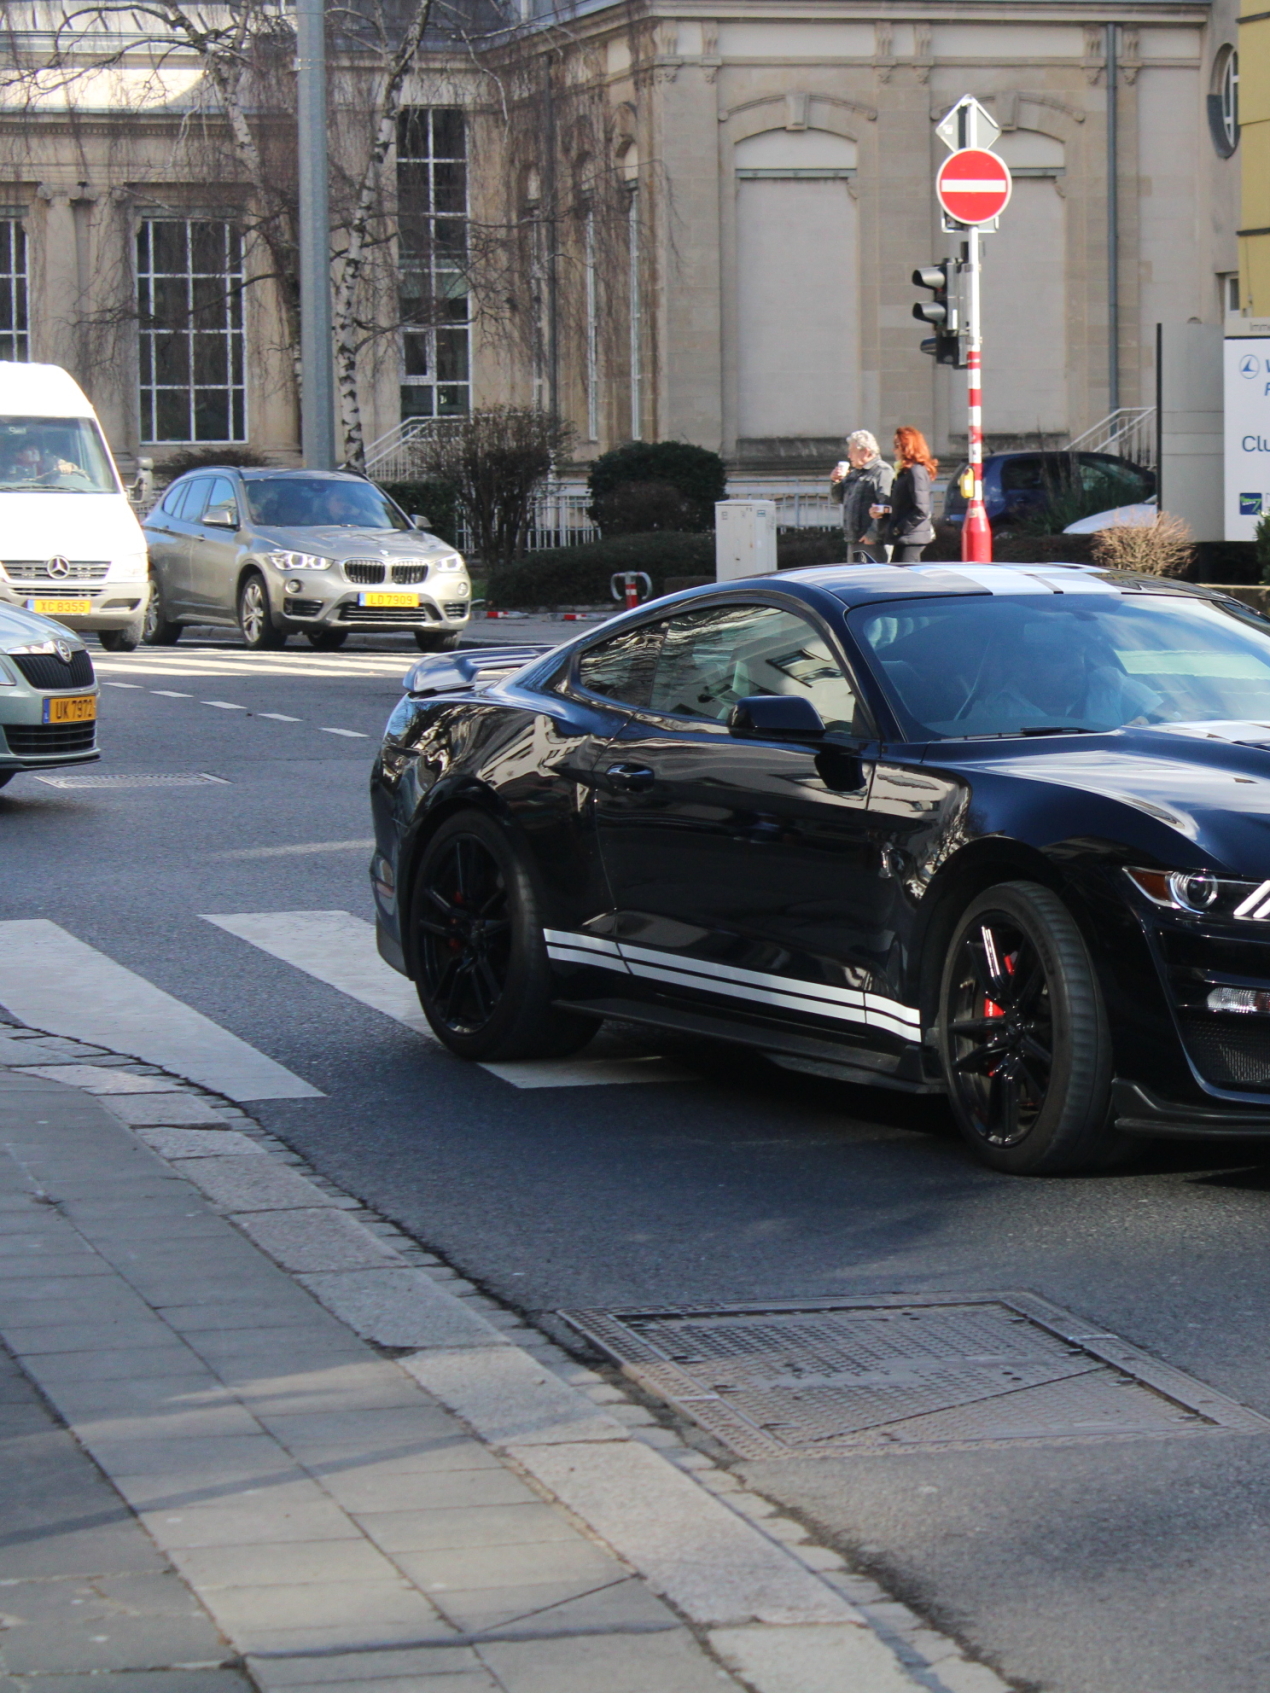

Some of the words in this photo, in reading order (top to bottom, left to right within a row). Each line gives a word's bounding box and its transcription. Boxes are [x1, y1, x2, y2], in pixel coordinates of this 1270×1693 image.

[386, 594, 413, 605] 7909
[40, 601, 55, 612] XC
[57, 601, 86, 612] 8355
[55, 700, 70, 720] UK
[71, 699, 92, 719] 7972
